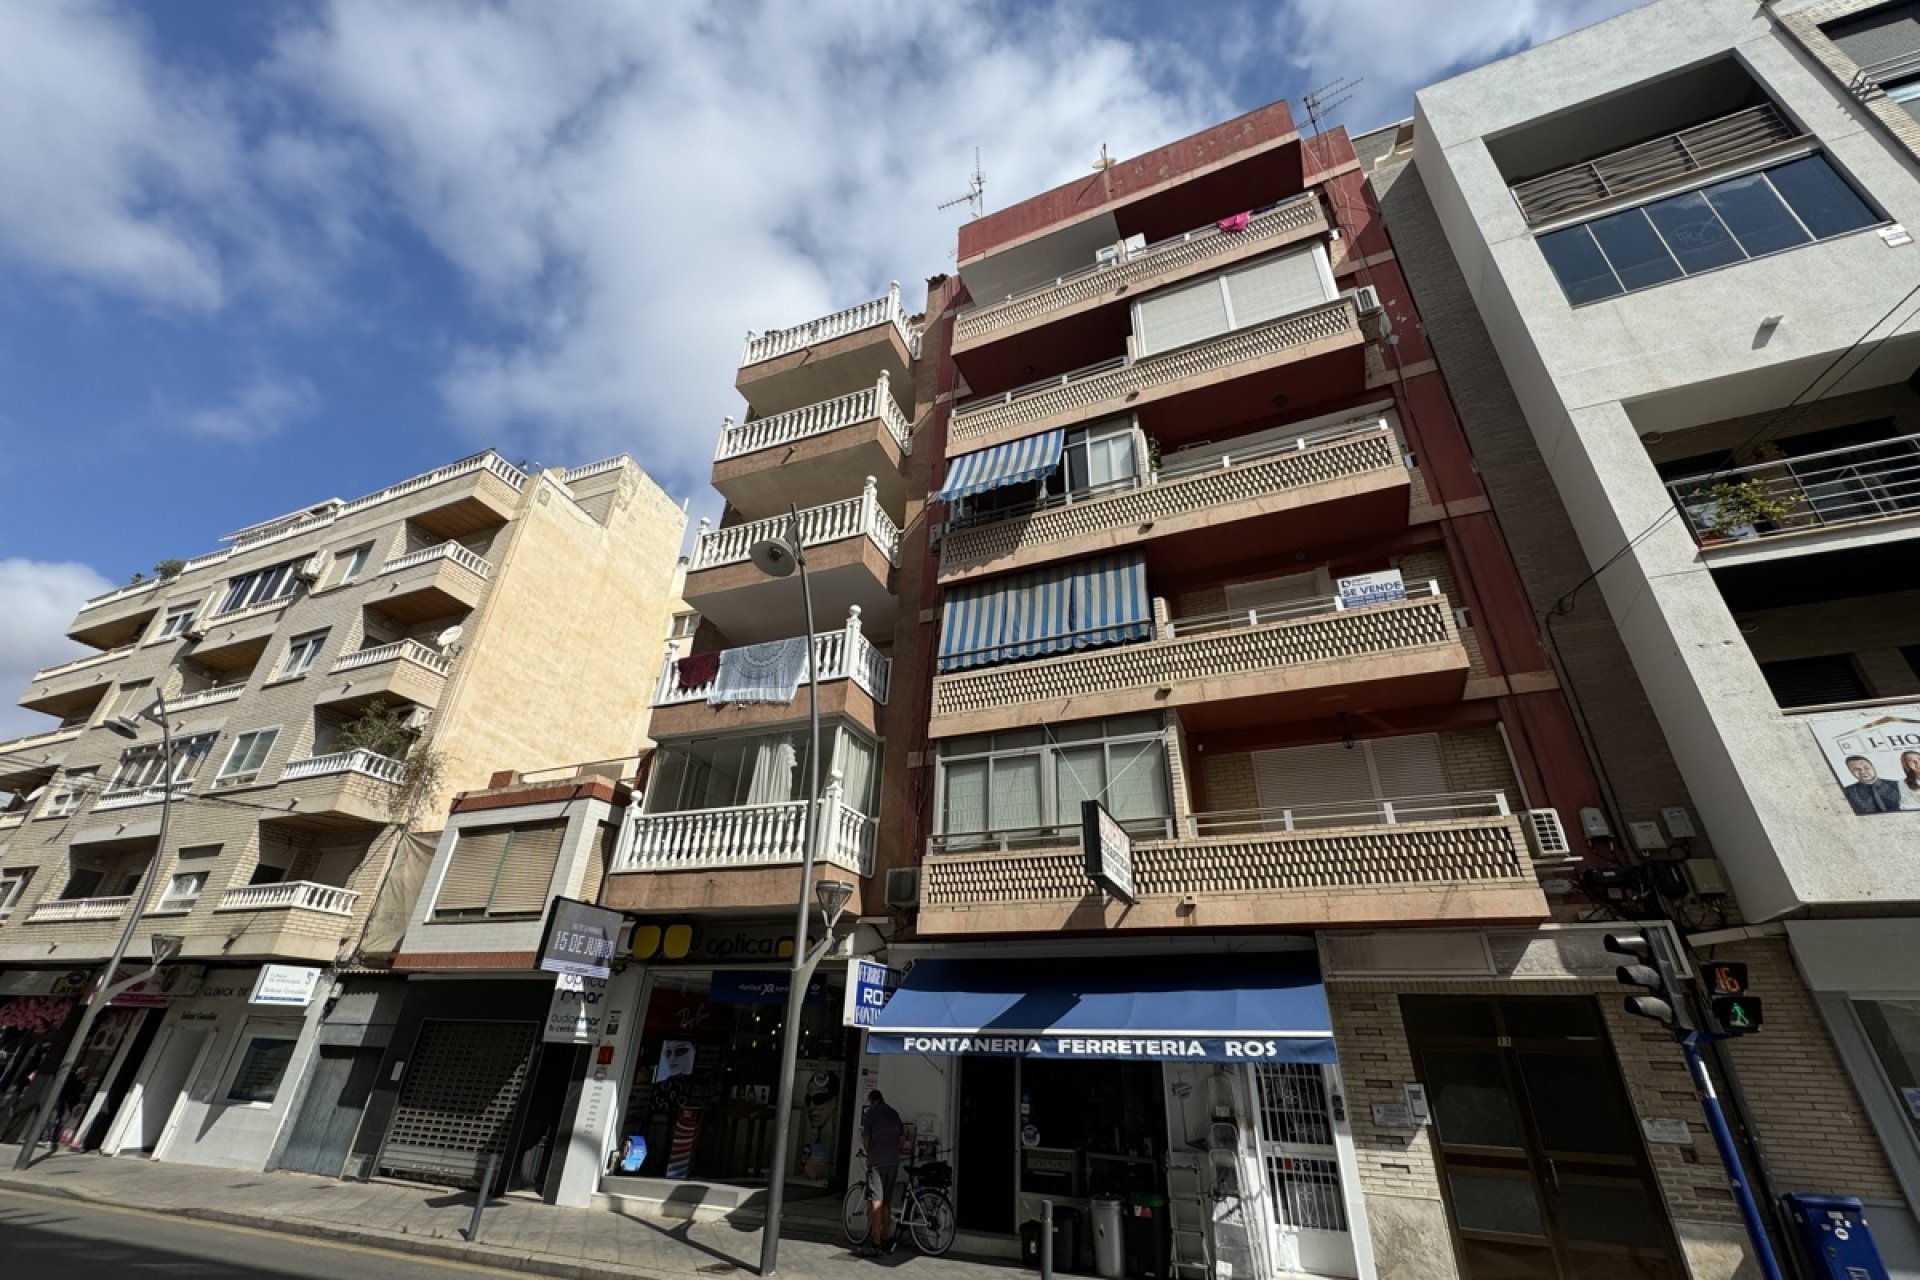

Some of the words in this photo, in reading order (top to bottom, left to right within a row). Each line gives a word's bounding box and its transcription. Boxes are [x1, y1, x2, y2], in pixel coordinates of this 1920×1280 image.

[1360, 580, 1401, 594] VENDE
[568, 933, 586, 953] DE
[903, 1036, 1042, 1054] FONTANERIA
[1057, 1038, 1207, 1057] FERRETERIA
[1224, 1040, 1279, 1058] ROS
